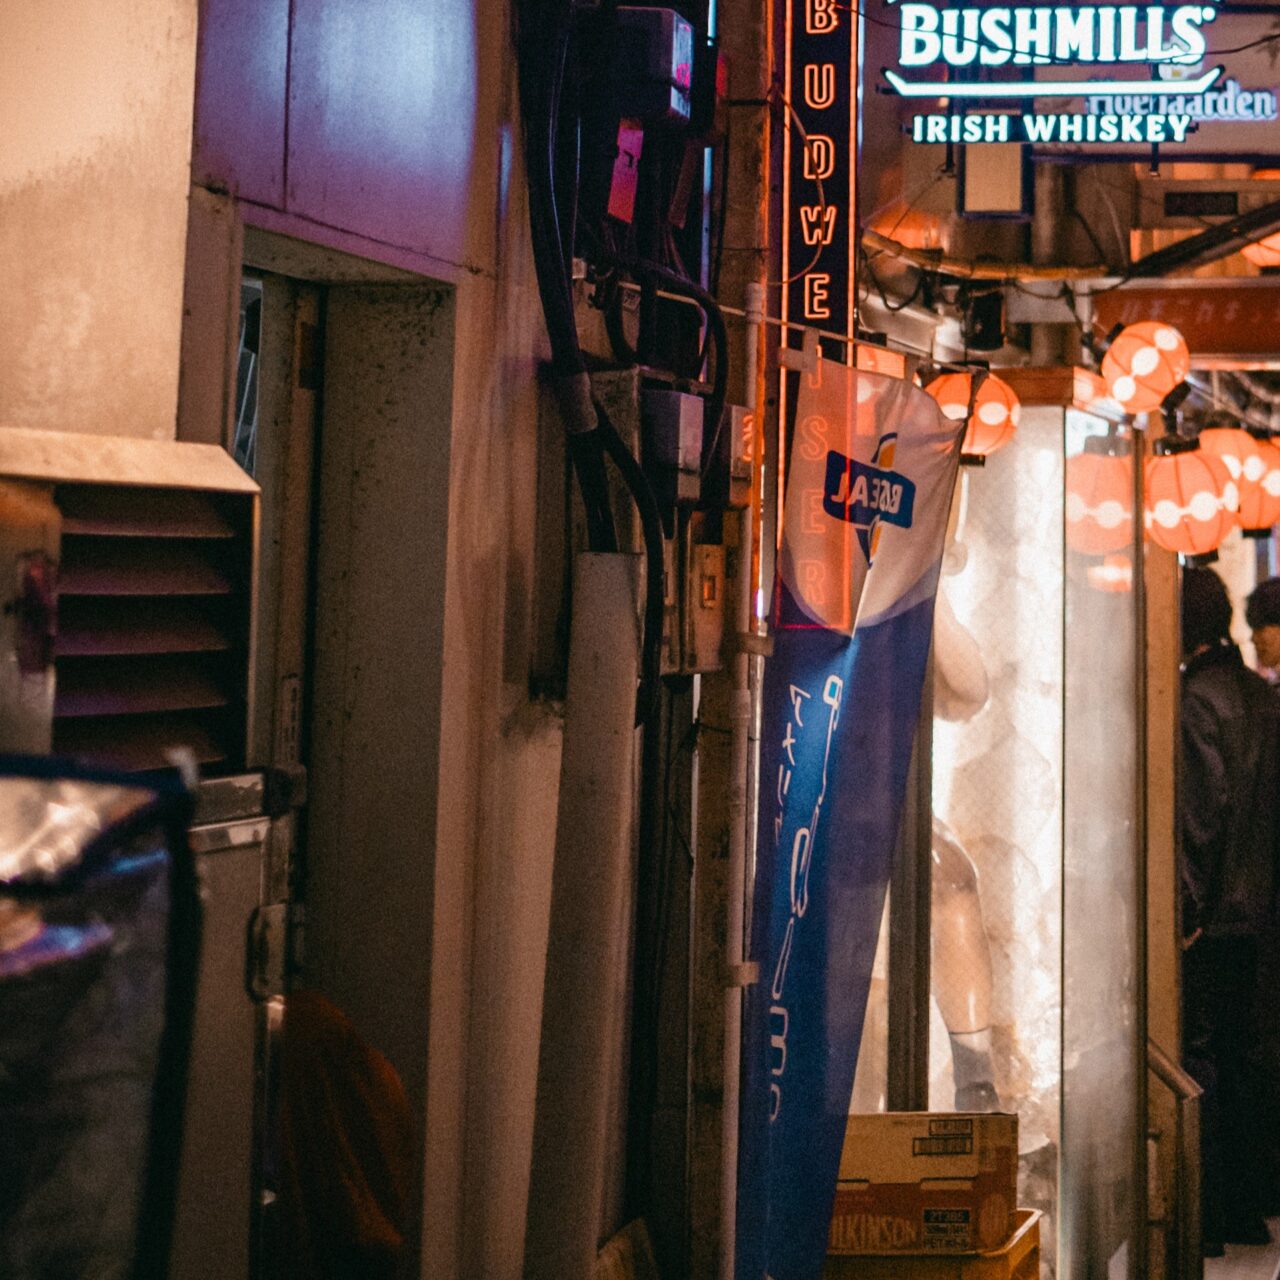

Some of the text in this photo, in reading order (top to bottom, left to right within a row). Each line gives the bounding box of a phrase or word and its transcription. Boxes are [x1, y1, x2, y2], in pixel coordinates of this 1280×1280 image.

[899, 3, 1206, 66] BUSHMILLS
[1088, 79, 1277, 120] Hoeaarden
[913, 113, 1191, 143] IRISH WHISKEY
[832, 1215, 917, 1250] ILKINSON
